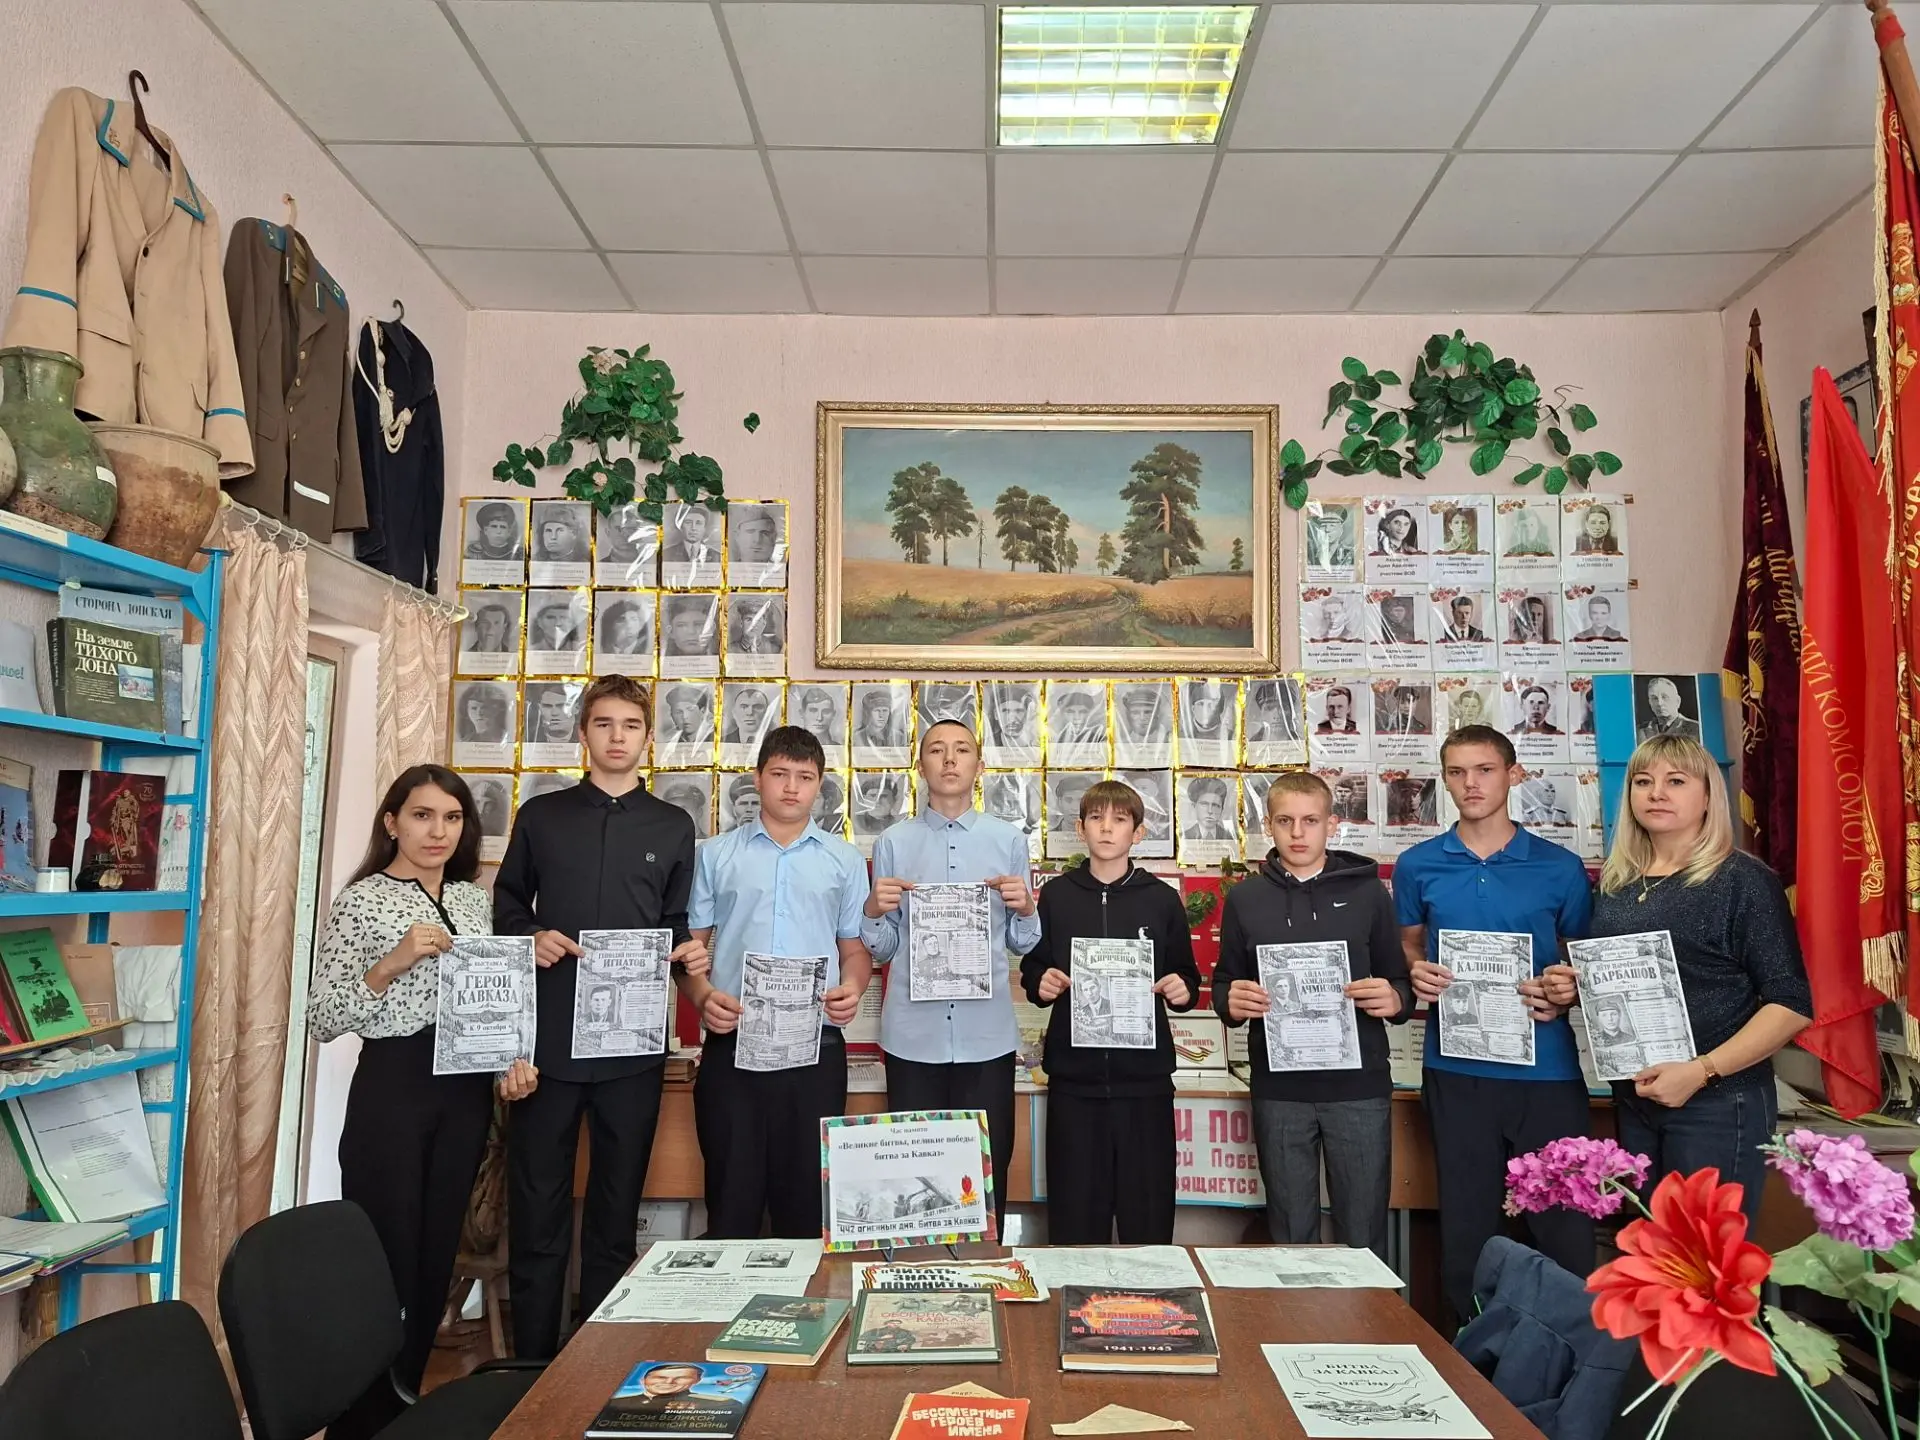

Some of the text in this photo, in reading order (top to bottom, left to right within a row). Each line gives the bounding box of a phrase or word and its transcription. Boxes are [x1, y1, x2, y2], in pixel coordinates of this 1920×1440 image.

[75, 627, 134, 650] На земле
[75, 641, 138, 665] ТИХОГО
[75, 656, 119, 676] ДОНА
[1812, 687, 1865, 864] КОМСОМОЛ
[603, 959, 646, 968] ИГНАТОВ
[1456, 961, 1513, 976] КАЛИНИН
[465, 974, 512, 989] ГЕРОИ
[1592, 966, 1658, 985] БАРБАШОВ
[457, 988, 519, 1006] КАВКАЗА
[911, 1137, 944, 1145] великие
[874, 1151, 944, 1161] битва за Кавказ»
[839, 1224, 855, 1234] 442
[880, 1311, 944, 1319] ОБОРОНА
[734, 1318, 797, 1328] ВОЙНА
[911, 1407, 1016, 1421] БЕССМЕРТНЫЕ
[930, 1416, 985, 1428] ГЕРОЕВ
[947, 1424, 1003, 1437] ИМЕНА
